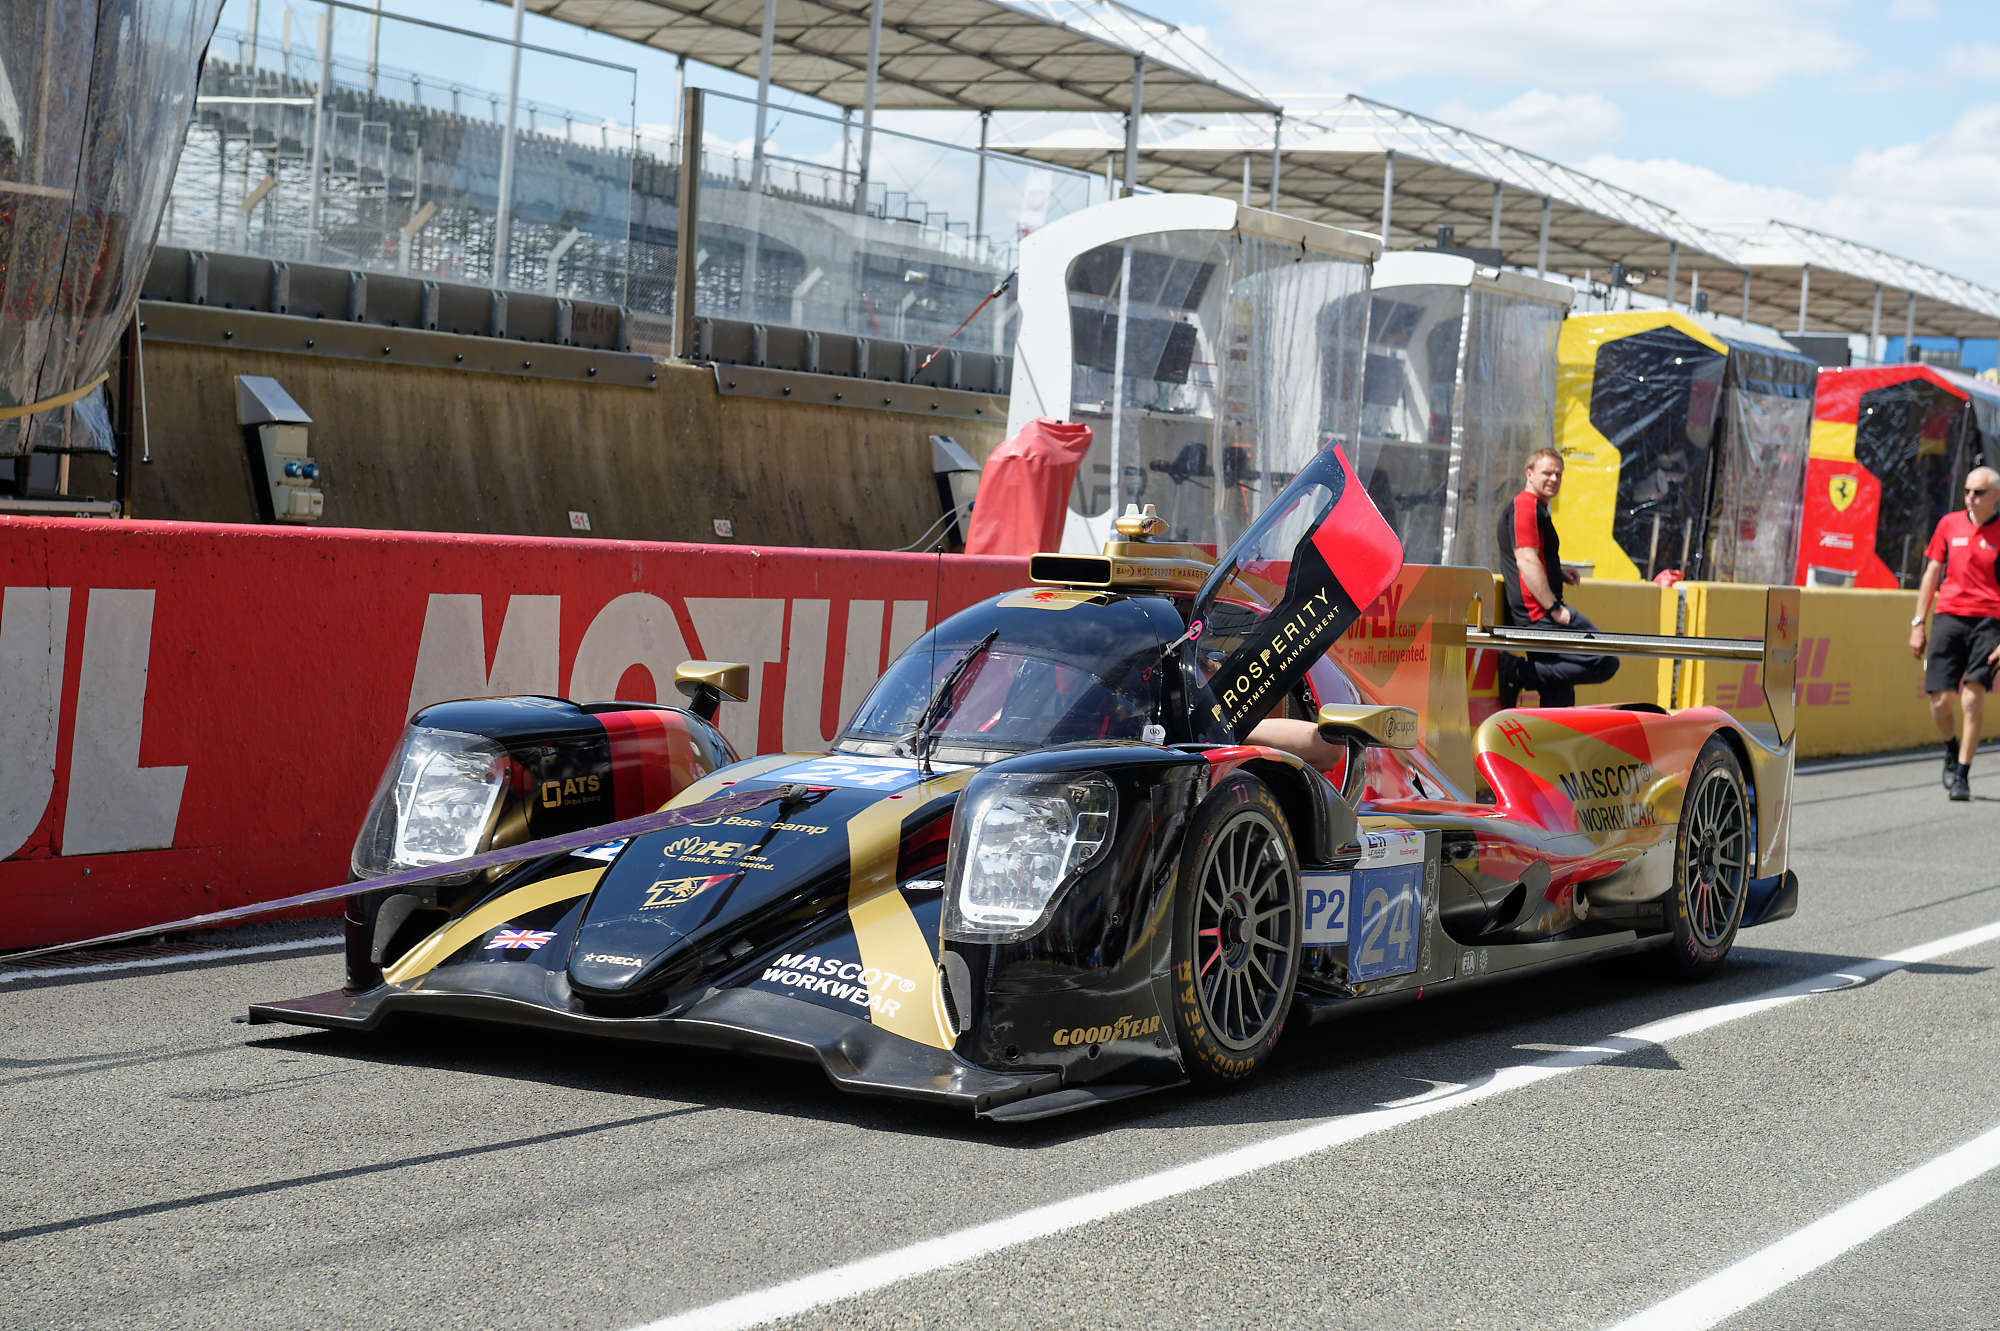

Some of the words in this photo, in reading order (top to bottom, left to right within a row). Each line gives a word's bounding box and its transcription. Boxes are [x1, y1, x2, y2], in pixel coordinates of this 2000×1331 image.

[573, 514, 587, 527] 41
[1211, 587, 1329, 722] PROSPERITY
[1378, 643, 1427, 664] reinvented.
[1223, 673, 1276, 734] INVESTMENT
[1279, 605, 1340, 672] MANAGEMENT
[564, 775, 600, 796] ATS
[780, 765, 912, 786] 24
[722, 816, 830, 836] Basecamp
[1577, 803, 1656, 832] WORKWEAR
[677, 855, 711, 865] Email,
[1304, 889, 1346, 930] P2
[1360, 883, 1413, 966] 24
[596, 954, 642, 967] ORECA
[761, 968, 902, 1019] WORKWEAR
[1053, 1015, 1161, 1046] GOODYEAR
